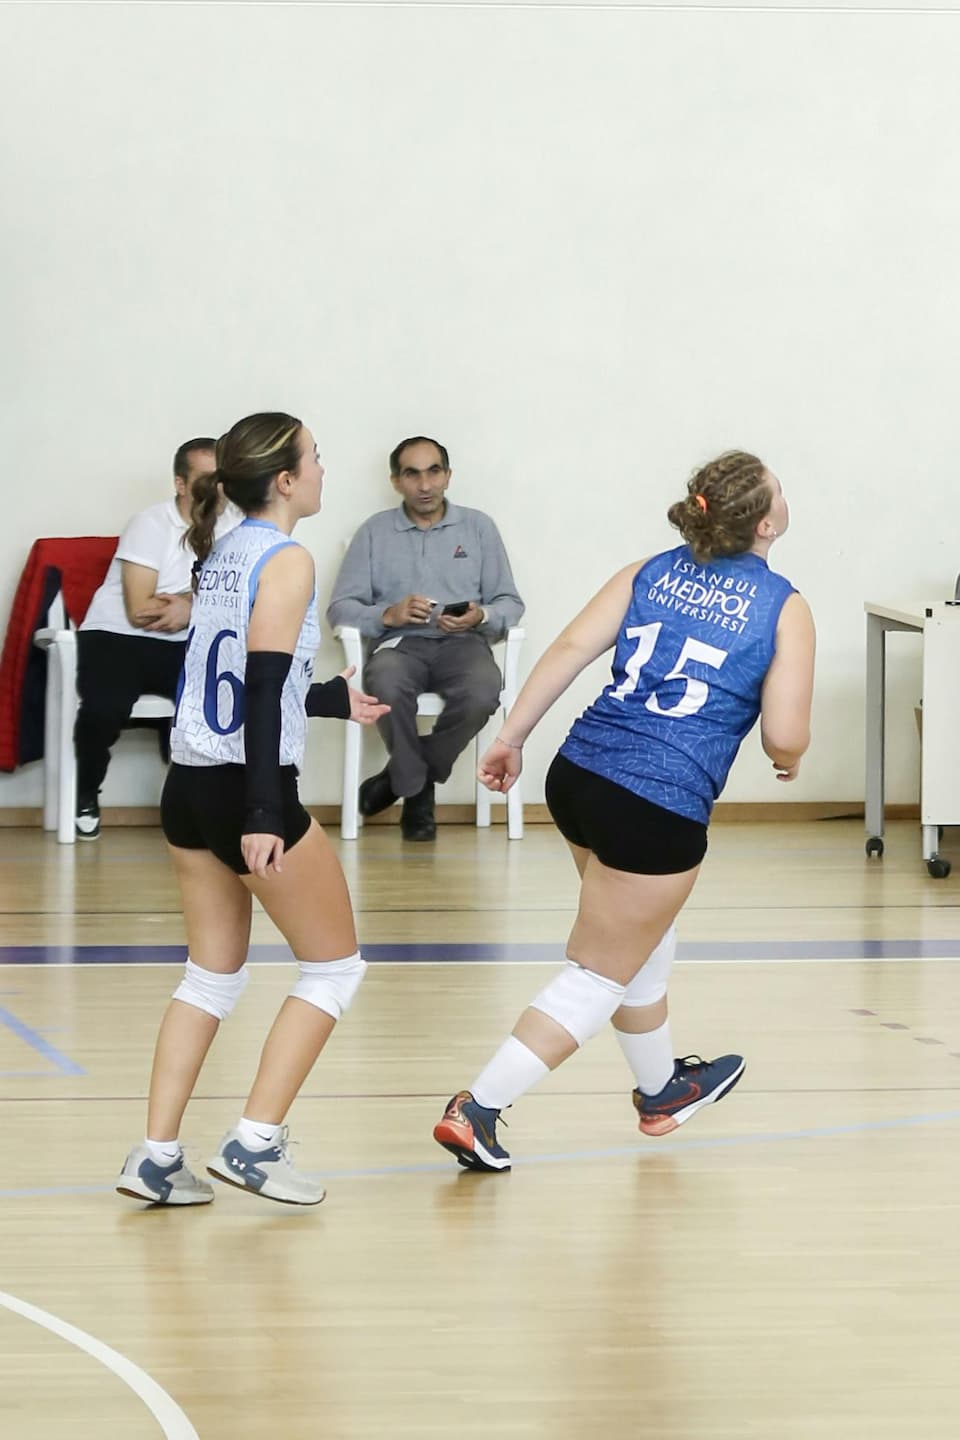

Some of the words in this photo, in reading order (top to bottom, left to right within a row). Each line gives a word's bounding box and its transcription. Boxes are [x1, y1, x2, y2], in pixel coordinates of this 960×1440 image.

[654, 571, 752, 622] MEDİPOL
[173, 625, 246, 736] 6
[608, 621, 729, 718] 15
